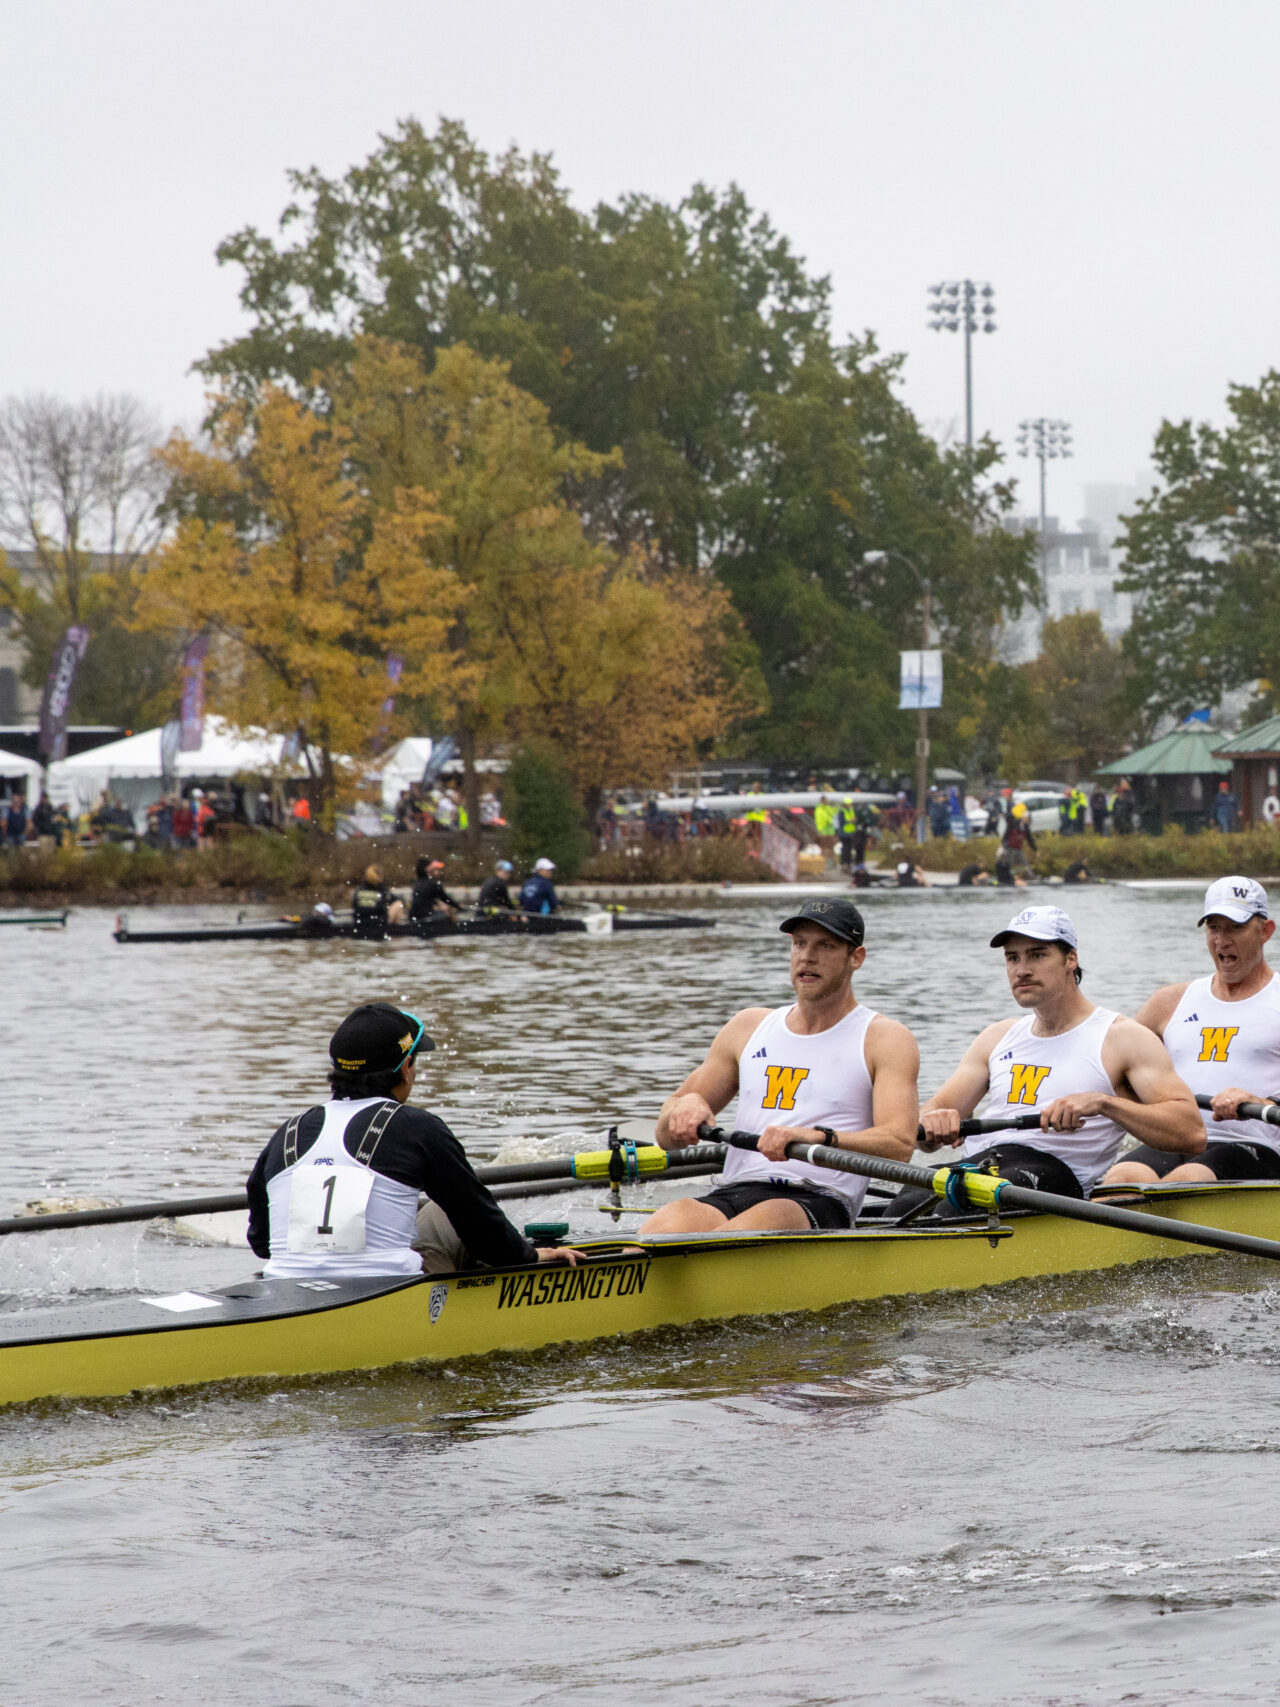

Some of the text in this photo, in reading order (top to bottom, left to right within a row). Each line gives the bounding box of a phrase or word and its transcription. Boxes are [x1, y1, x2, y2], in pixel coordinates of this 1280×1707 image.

[811, 902, 834, 914] W
[1232, 887, 1249, 899] W
[1197, 1026, 1240, 1062] W
[761, 1065, 811, 1110] W
[1007, 1064, 1052, 1106] W
[317, 1175, 337, 1234] 1
[456, 1276, 497, 1290] EMPACHER
[498, 1262, 652, 1310] WASHINGTON
